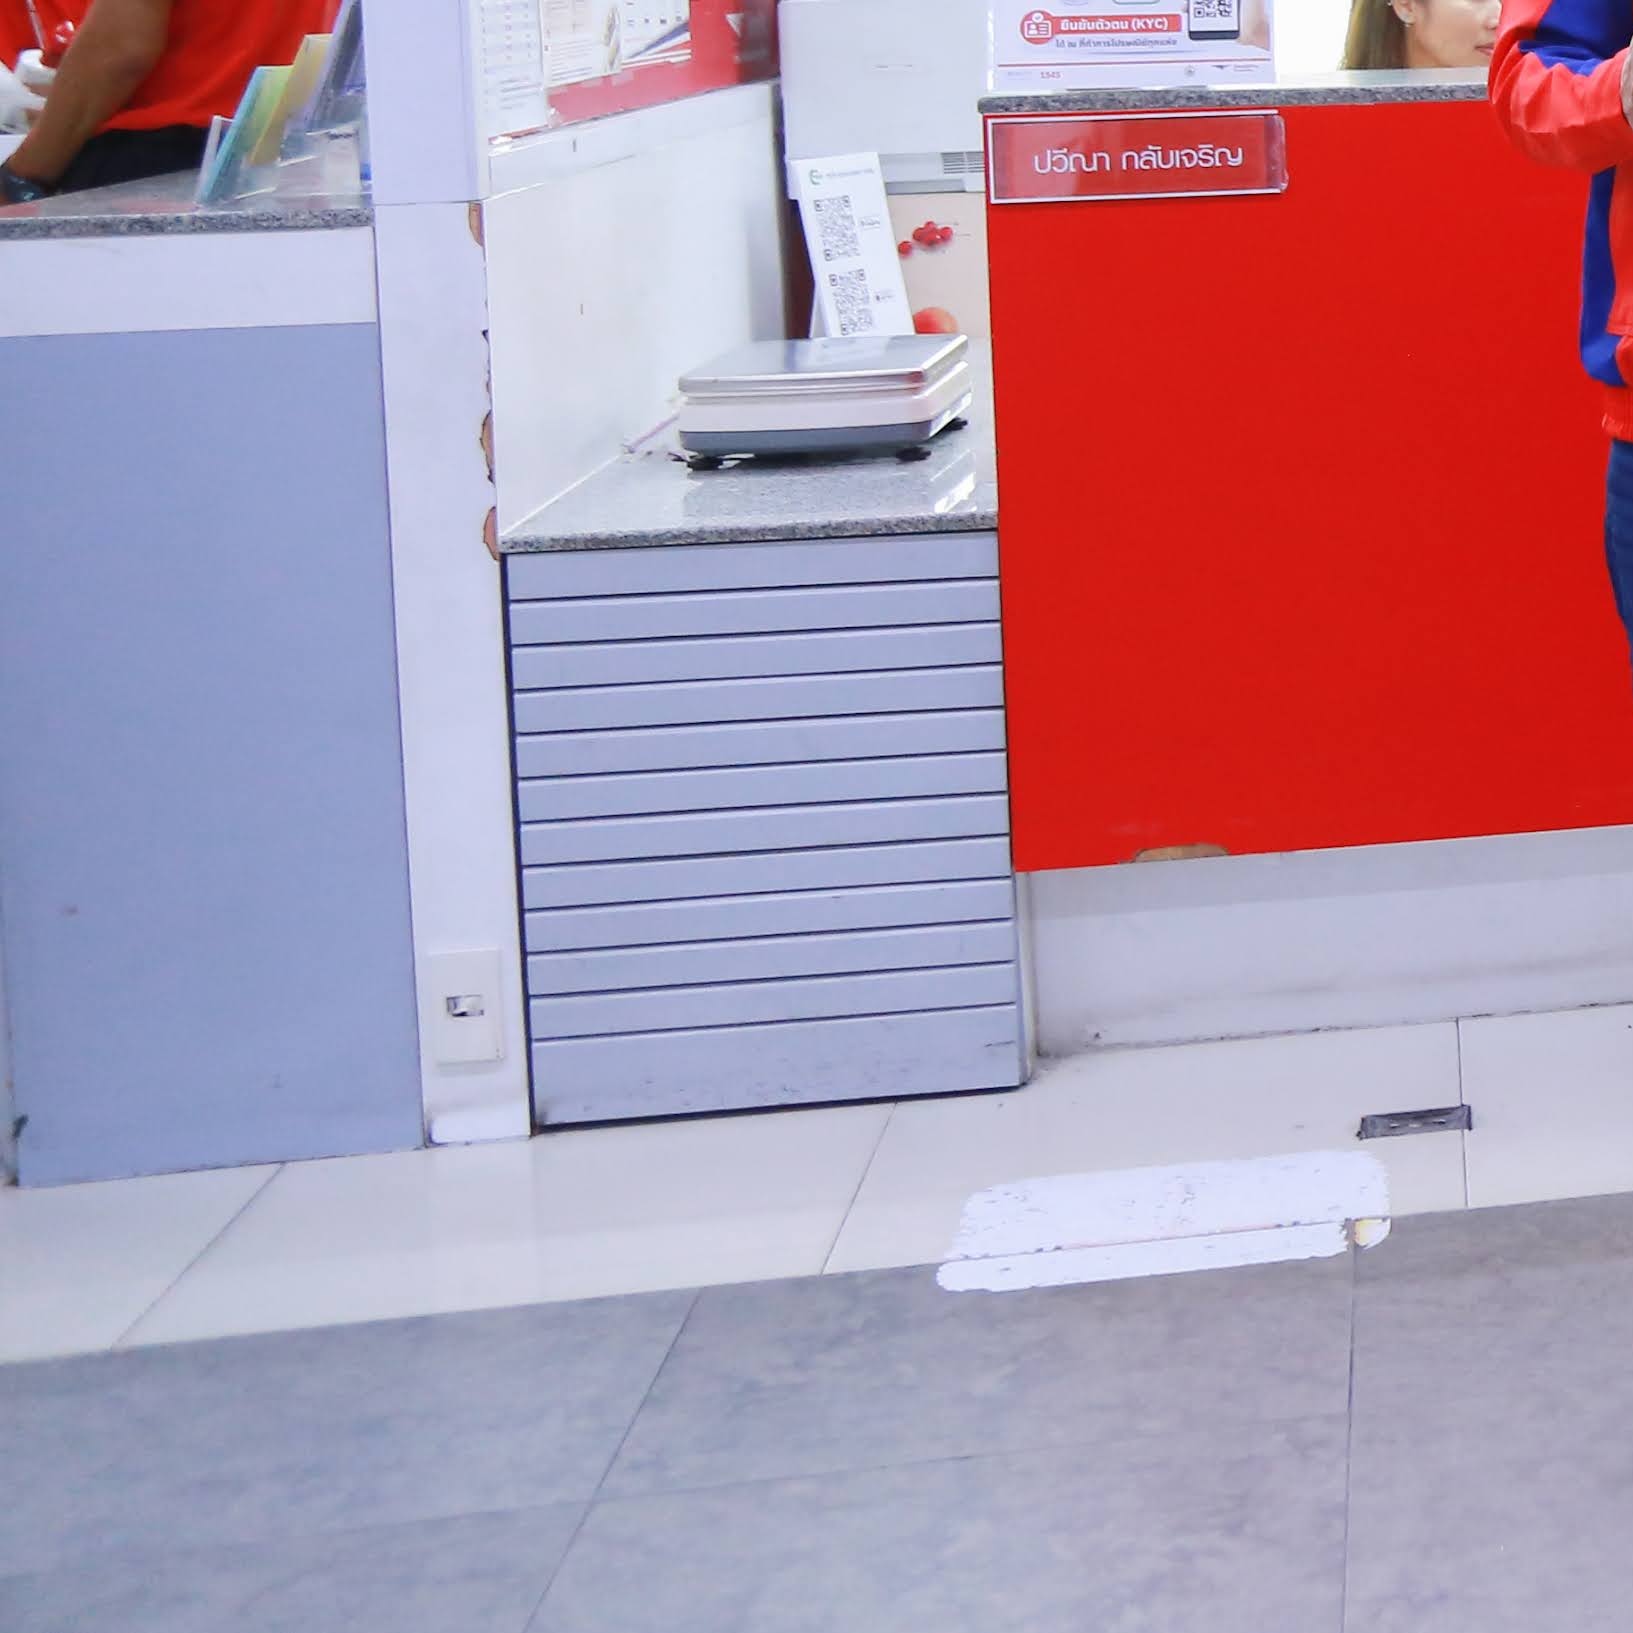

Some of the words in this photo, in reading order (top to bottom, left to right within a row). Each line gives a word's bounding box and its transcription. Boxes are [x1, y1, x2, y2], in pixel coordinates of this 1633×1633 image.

[1060, 15, 1129, 32] ยืนยันตัวตน
[1132, 15, 1168, 32] (KYC)
[1033, 147, 1111, 175] ปวีณา
[1122, 142, 1244, 173] กลับเจริญ
